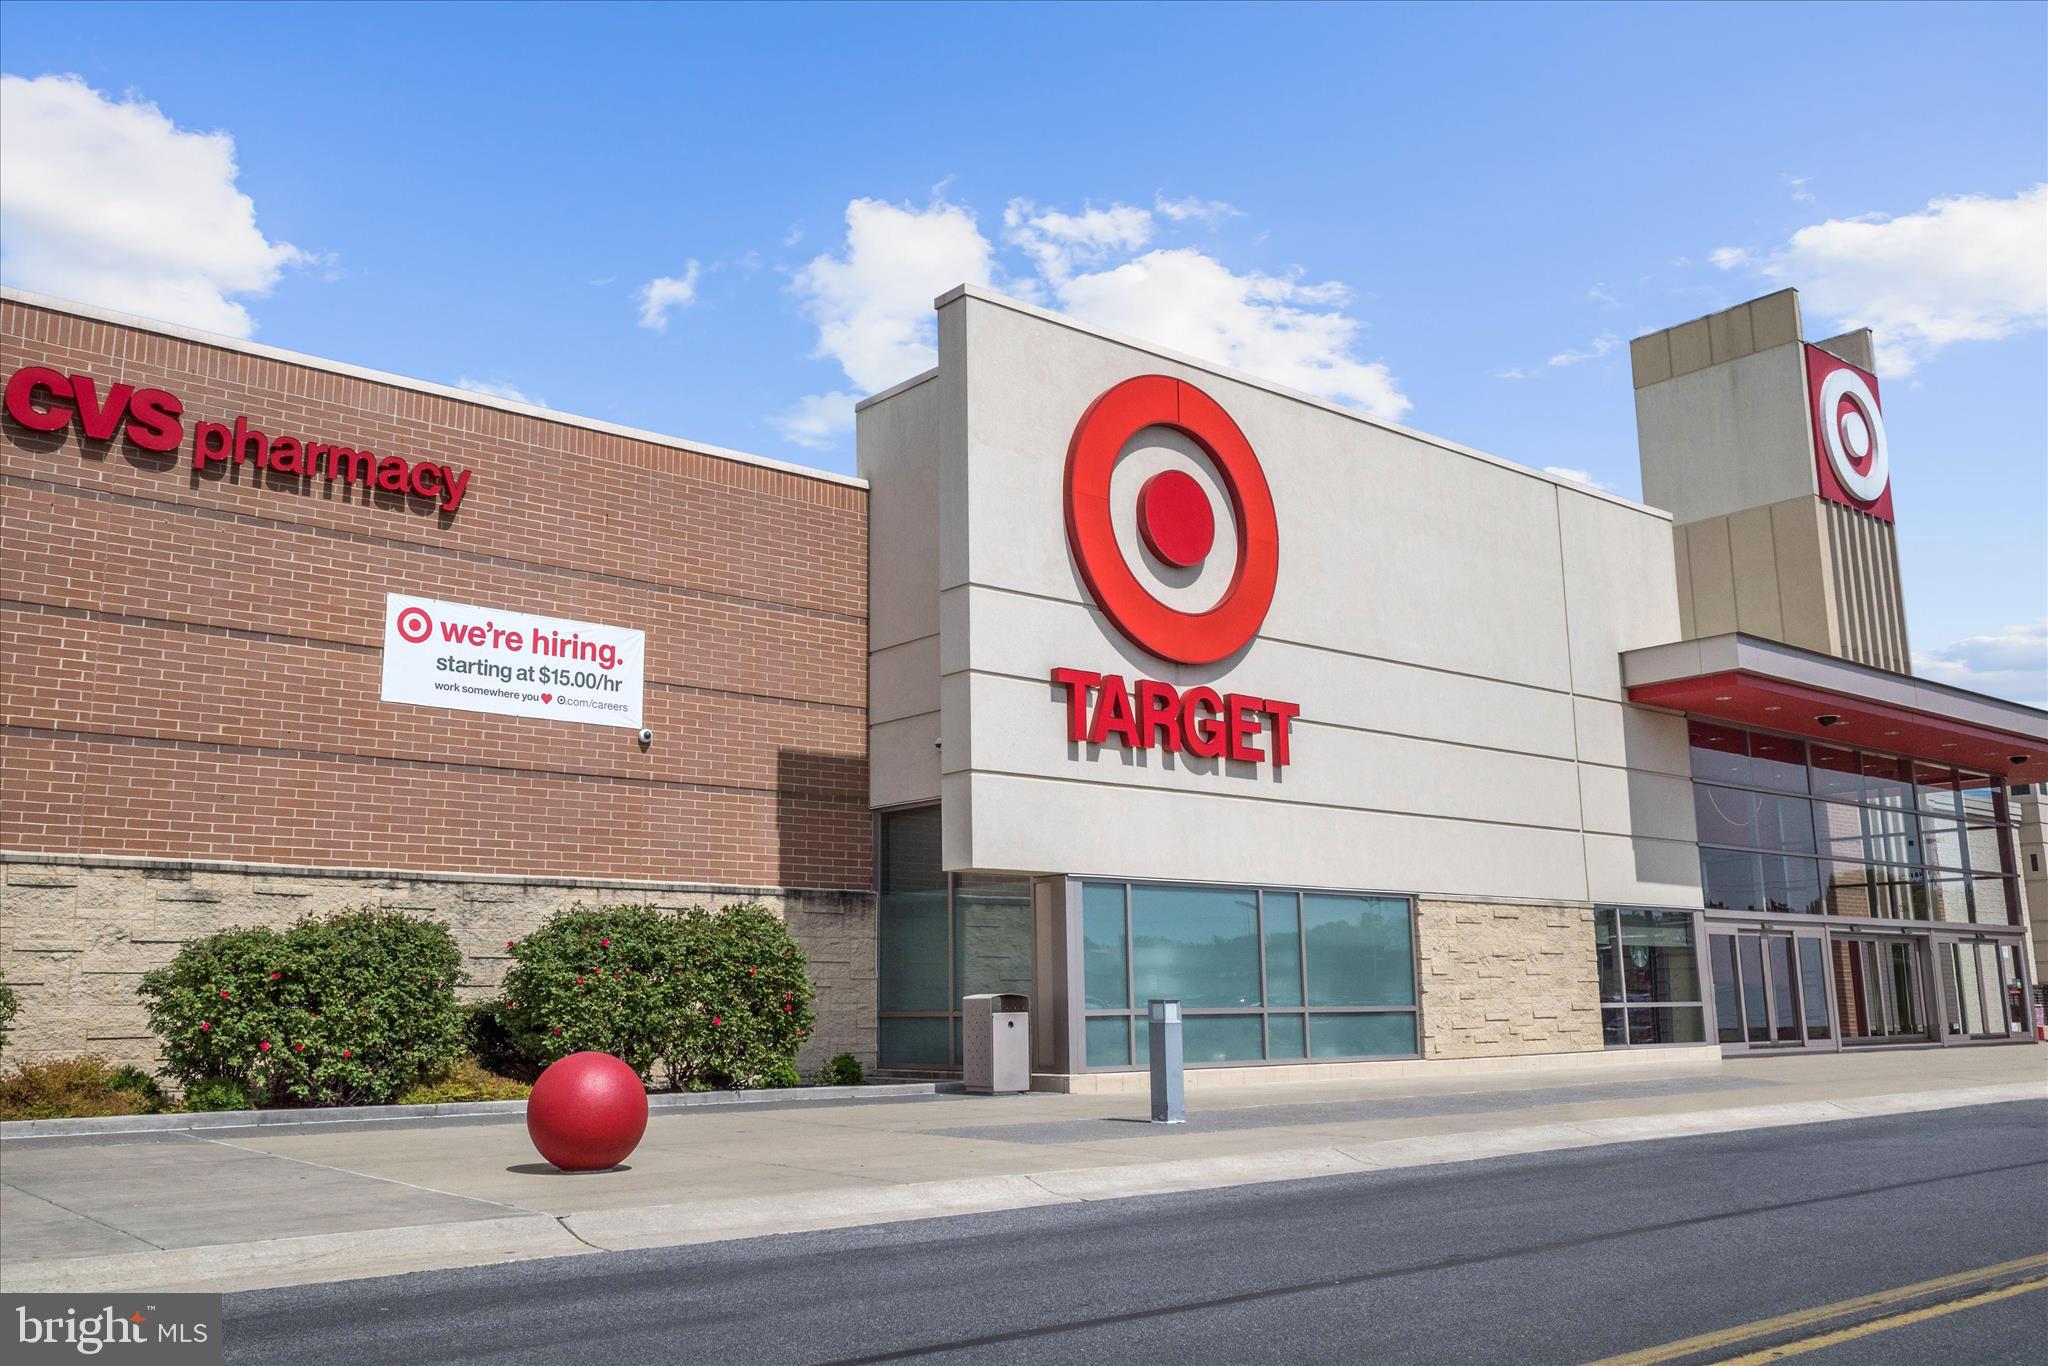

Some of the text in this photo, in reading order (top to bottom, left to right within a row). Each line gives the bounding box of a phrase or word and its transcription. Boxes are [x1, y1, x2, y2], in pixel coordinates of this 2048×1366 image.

[4, 366, 472, 511] CVS pharmacy
[440, 621, 623, 670] we're hiring.
[434, 681, 460, 693] work
[461, 685, 520, 700] somewhere
[521, 690, 539, 702] you
[436, 655, 623, 692] starting at $15.00/hr
[1050, 667, 1300, 766] TARGET
